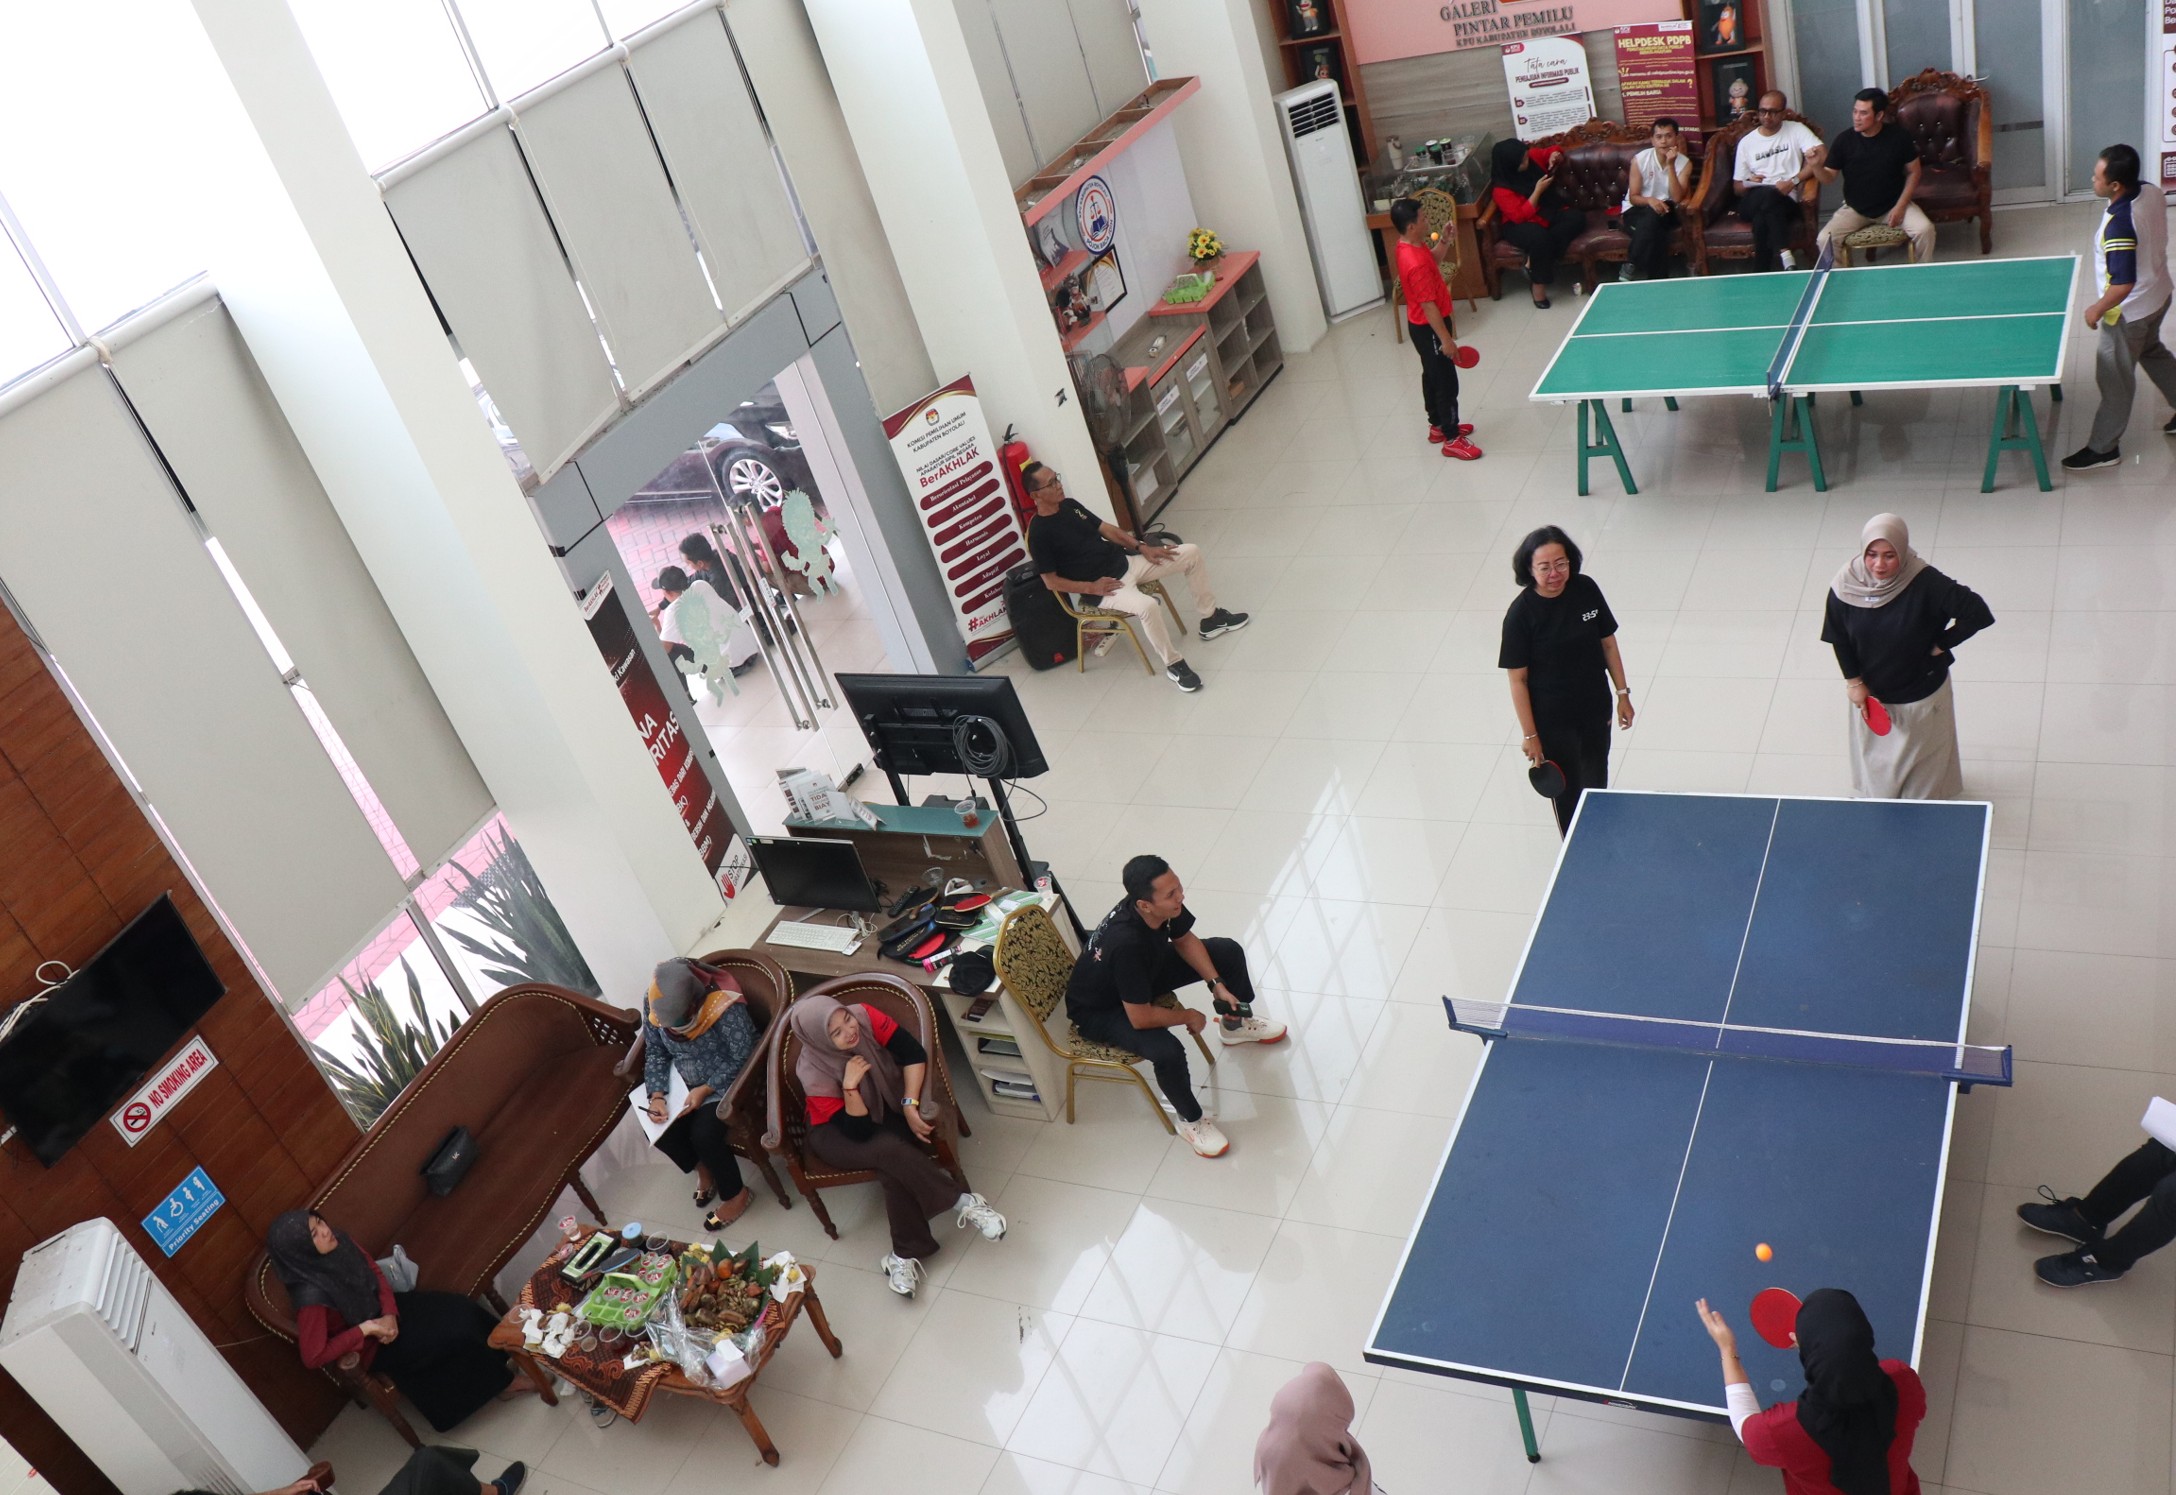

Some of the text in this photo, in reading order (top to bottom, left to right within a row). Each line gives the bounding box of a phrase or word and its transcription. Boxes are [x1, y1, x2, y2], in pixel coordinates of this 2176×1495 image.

[1440, 0, 1498, 20] GALERI
[1454, 6, 1574, 36] PINTAR PEMILU
[1456, 22, 1577, 47] KPU KABUPATEN BOYOLALI
[1618, 35, 1692, 48] HELPDESK PDPB
[1515, 73, 1540, 83] PENGAJUAN
[1541, 70, 1564, 79] INFORMASI
[1564, 67, 1580, 76] PUBLIK
[1523, 57, 1545, 73] Tata
[907, 411, 966, 448] KOMISI PEMILIHAN UMUM
[913, 420, 965, 453] KABUPATEN BOYOLALI
[916, 435, 976, 473] NILAI DASAR/CORE VALUES
[920, 443, 974, 476] APARATUR SIPIL NEGARA
[919, 446, 980, 488] BerAKHLAK
[930, 468, 982, 502] Berorientasi Pelayanan
[952, 494, 977, 512] Akuntabel
[958, 514, 982, 530] Kompeten
[965, 530, 988, 546] Harmonis
[976, 550, 990, 562] Loyal
[982, 566, 999, 580] Adaptif
[616, 649, 636, 678] Kawasan
[677, 765, 687, 784] DARI
[814, 800, 830, 811] BIAY
[690, 818, 703, 842] BERSIH
[700, 807, 710, 825] DAN
[727, 854, 739, 880] STOP
[148, 1048, 208, 1109] NO SMOKING AREA
[168, 1223, 194, 1251] Priority
[193, 1199, 220, 1225] Seating
